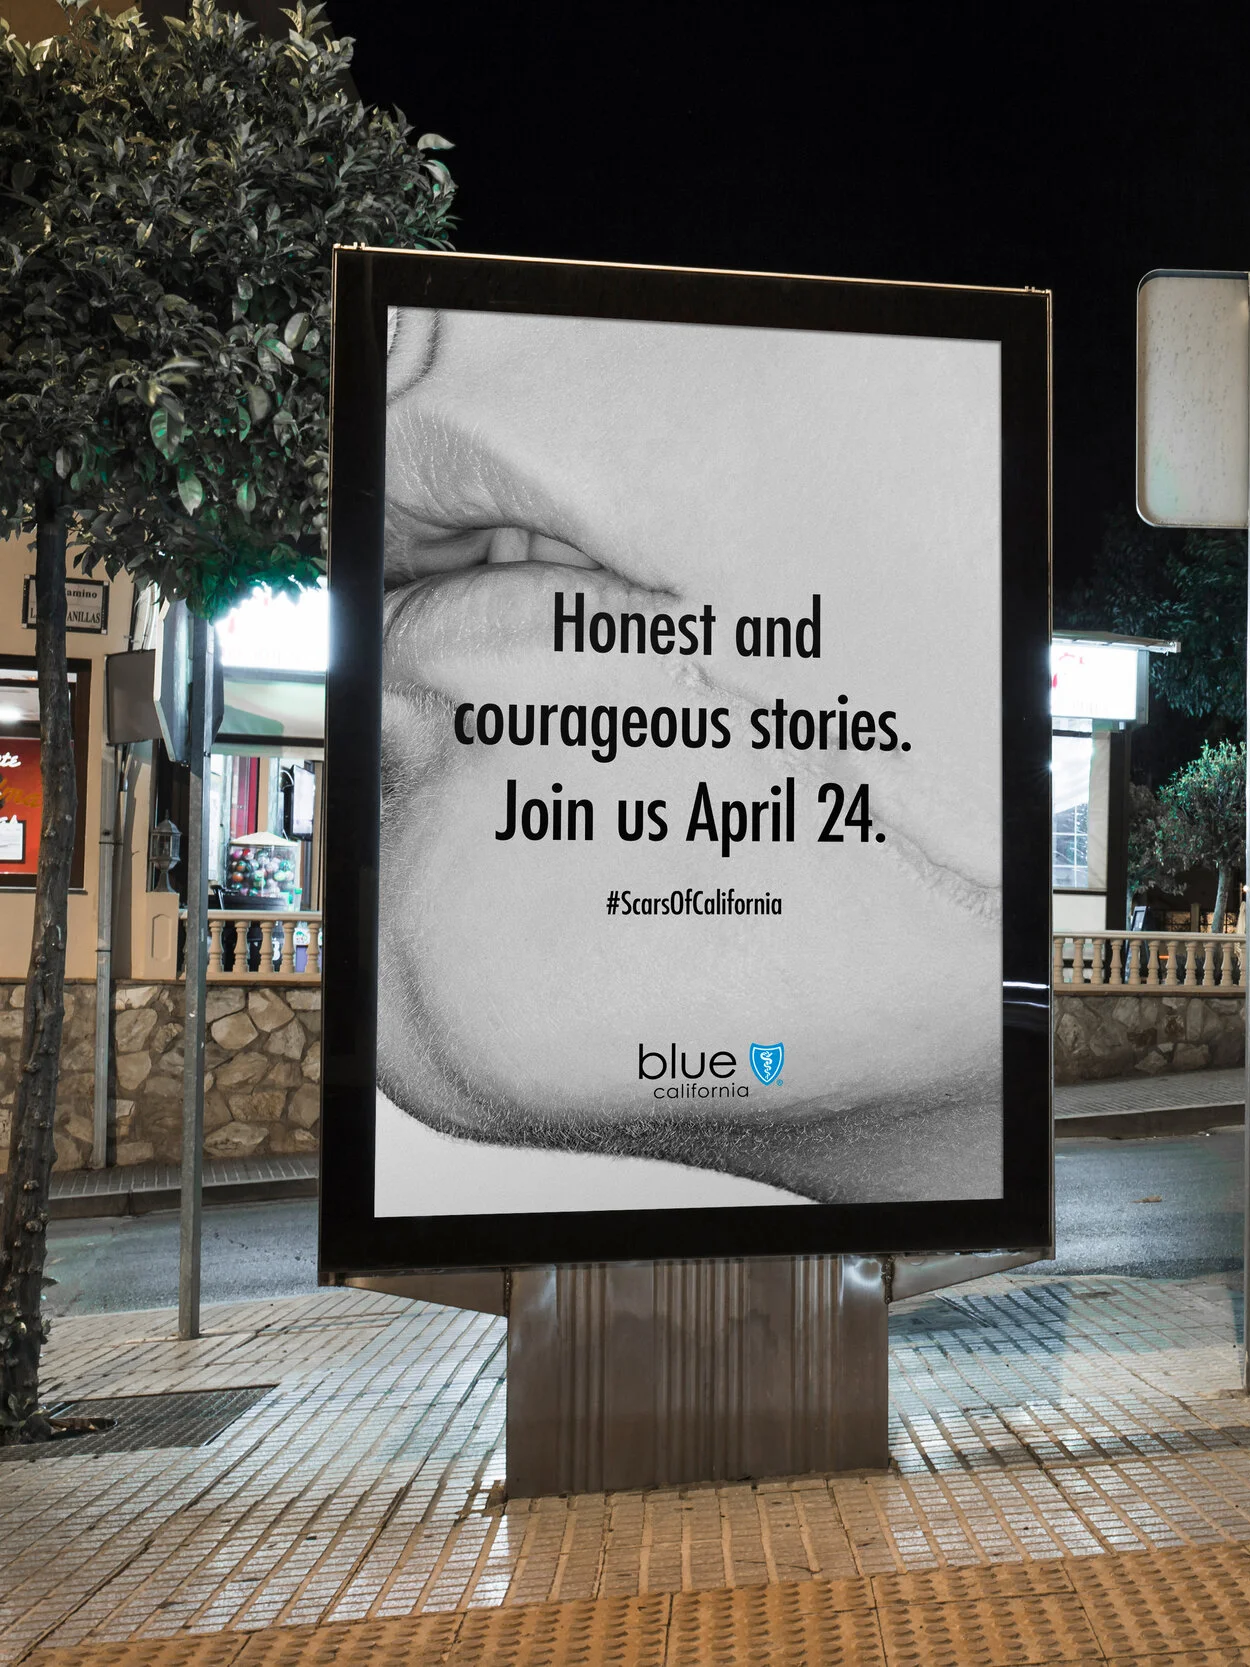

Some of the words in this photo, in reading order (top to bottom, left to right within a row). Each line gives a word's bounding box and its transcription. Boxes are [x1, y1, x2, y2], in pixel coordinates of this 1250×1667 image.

[67, 588, 98, 599] amino
[554, 592, 716, 656] Honest
[735, 594, 821, 659] and
[454, 702, 731, 763] courageous
[750, 694, 912, 752] stories.
[495, 779, 594, 841] Join
[618, 799, 668, 842] us
[685, 777, 795, 858] April
[817, 782, 886, 843] 24.
[606, 888, 782, 916] #ScarsOfCalifornia
[638, 1042, 737, 1080] blue
[653, 1082, 749, 1100] california
